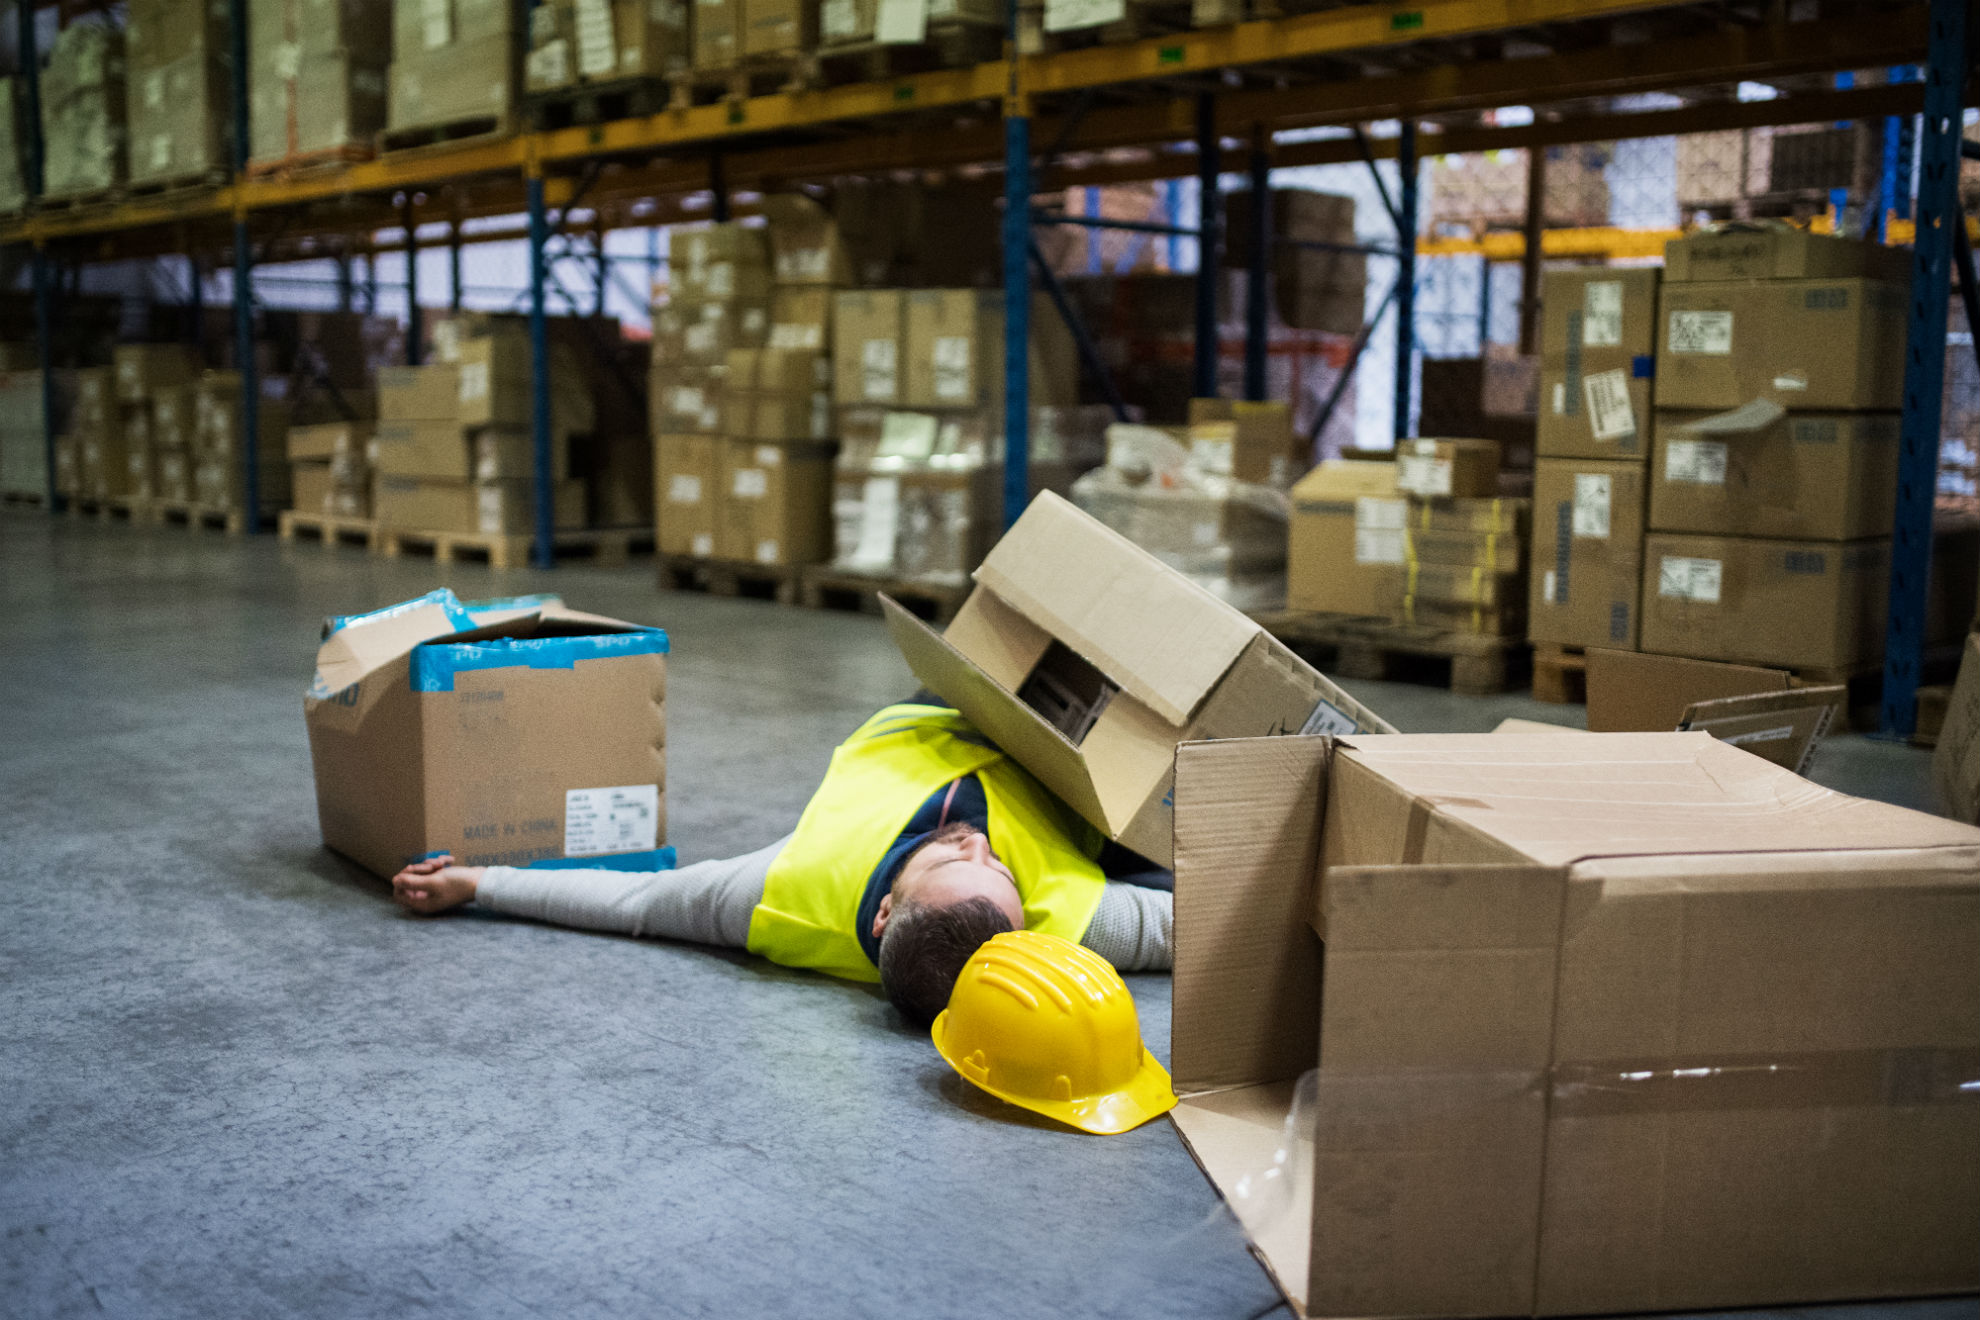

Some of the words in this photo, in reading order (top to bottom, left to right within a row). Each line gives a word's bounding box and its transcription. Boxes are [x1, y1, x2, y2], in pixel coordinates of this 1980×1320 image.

[463, 823, 497, 839] MADE
[503, 821, 516, 835] IN
[520, 817, 557, 833] CHINA
